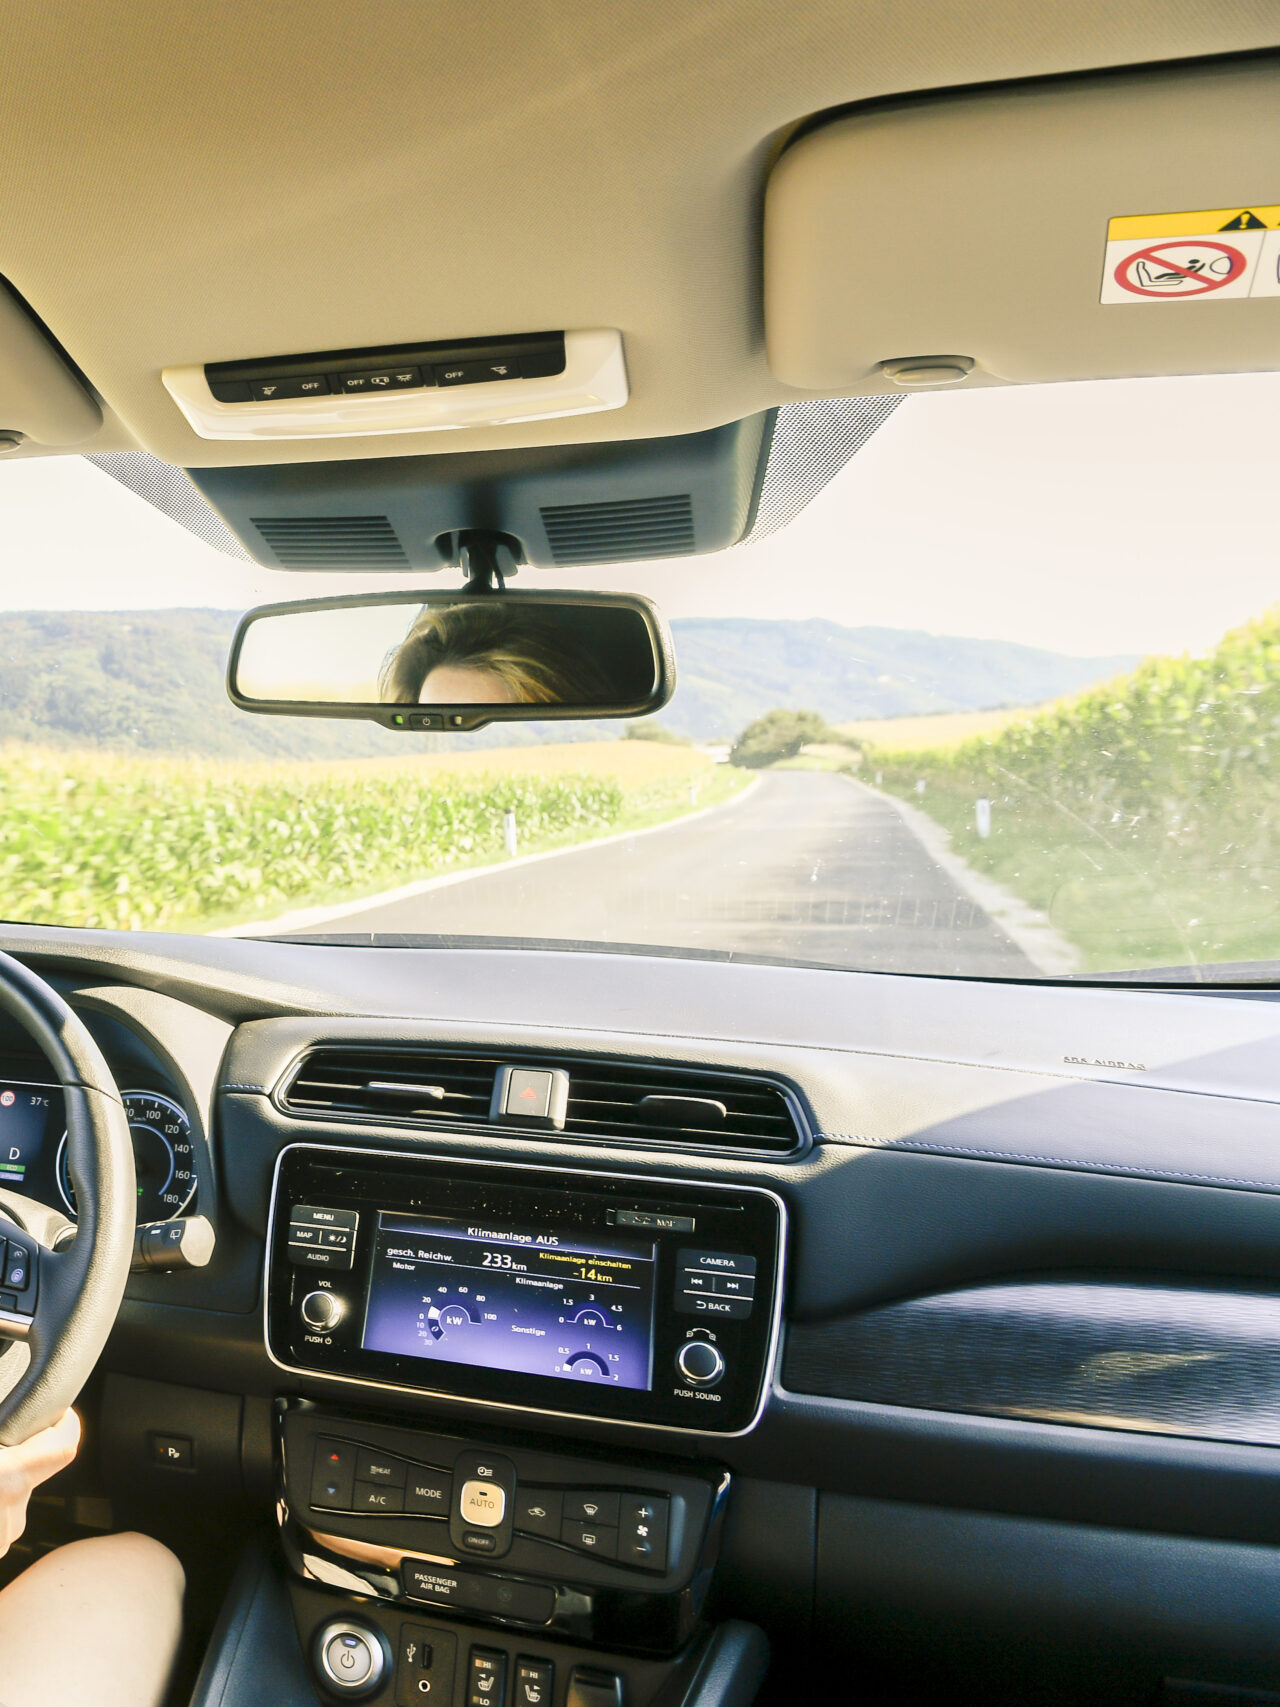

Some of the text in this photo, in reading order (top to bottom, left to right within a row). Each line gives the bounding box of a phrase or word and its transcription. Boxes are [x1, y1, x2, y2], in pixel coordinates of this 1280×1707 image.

[445, 371, 464, 379] OFF
[301, 382, 319, 390] OFF
[30, 1097, 41, 1106] 37
[146, 1110, 161, 1120] 100
[164, 1124, 180, 1134] 120
[174, 1143, 189, 1153] 140
[8, 1147, 20, 1160] D
[175, 1170, 190, 1180] 160
[163, 1194, 179, 1204] 180
[313, 1213, 334, 1221] MENU
[296, 1230, 313, 1239] MAP
[467, 1227, 559, 1246] Klimaanlage AUS
[307, 1253, 329, 1262] AUDIO
[387, 1248, 454, 1262] gesch. Reichw.
[539, 1252, 632, 1270] Klimaanlage einschalten
[700, 1257, 736, 1268] CAMERA
[392, 1262, 416, 1271] Motor
[318, 1280, 332, 1288] VOL
[515, 1277, 564, 1290] Klimaanlage
[563, 1298, 574, 1306] 1.5
[708, 1303, 731, 1312] BACK
[446, 1315, 463, 1325] kW
[584, 1318, 597, 1326] kW
[511, 1325, 546, 1336] Sonstige
[304, 1335, 323, 1344] PUSH
[558, 1347, 570, 1355] 0.5
[608, 1354, 620, 1362] 1.5
[674, 1388, 722, 1402] PUSH SOUND
[415, 1487, 442, 1499] MODE
[369, 1495, 386, 1505] A/C
[470, 1498, 495, 1509] AUTO
[415, 1573, 457, 1588] PASSENGER
[420, 1582, 450, 1594] AIR BAG
[482, 1661, 492, 1669] HI
[529, 1671, 539, 1679] HI
[479, 1698, 490, 1706] LO
